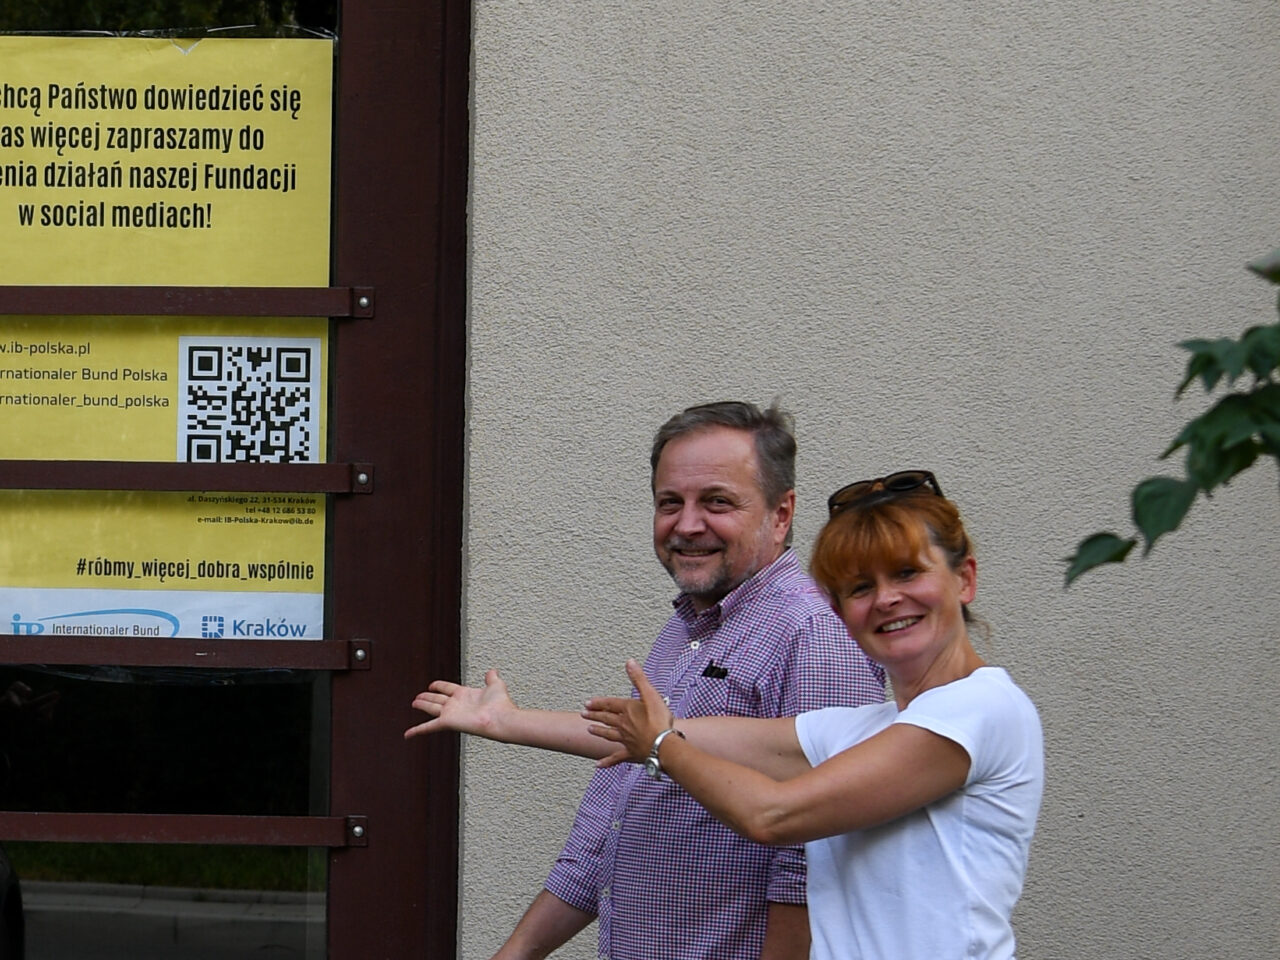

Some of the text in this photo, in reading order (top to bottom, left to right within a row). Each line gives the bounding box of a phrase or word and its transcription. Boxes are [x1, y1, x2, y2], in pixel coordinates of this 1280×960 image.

[48, 81, 137, 110] Państwo
[144, 83, 264, 112] dowiedzieć
[270, 84, 301, 120] się
[30, 121, 100, 157] więcej
[106, 127, 234, 154] zapraszamy
[239, 124, 264, 151] do
[44, 160, 123, 188] działań
[129, 162, 198, 192] naszej
[204, 163, 296, 193] Fundacji
[18, 200, 212, 229] w social mediach!
[81, 367, 118, 381] Bund
[122, 368, 168, 382] Polska
[287, 496, 317, 504] Kraków
[224, 516, 314, 525] IB-Polska-Krakow@ib.de
[245, 506, 256, 514] tel
[257, 506, 270, 514] +48
[296, 507, 306, 515] 53
[76, 556, 314, 583] #róbmy_więcej_dobra_wspólnie
[52, 623, 161, 637] Internationaler Bund
[233, 618, 307, 638] Kraków
